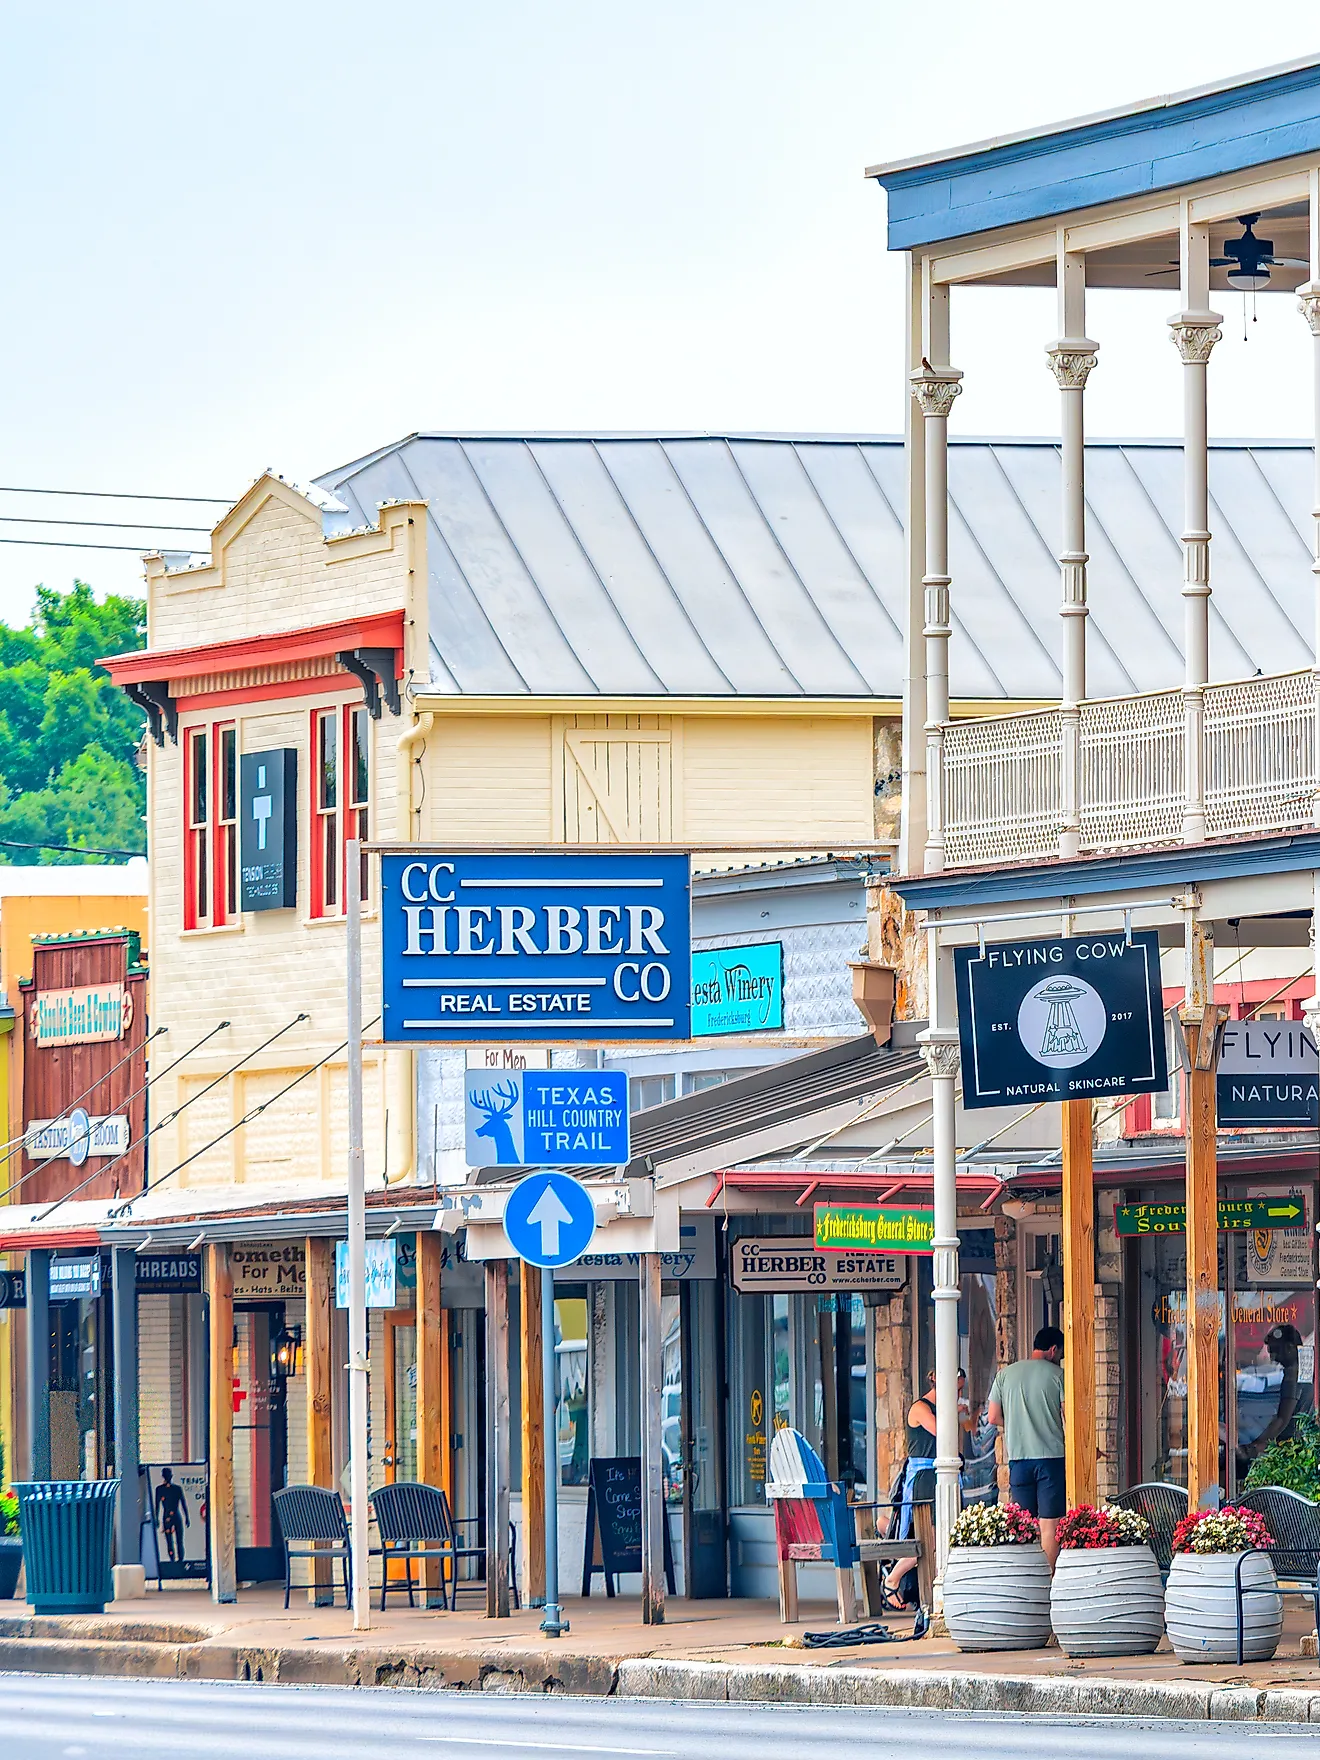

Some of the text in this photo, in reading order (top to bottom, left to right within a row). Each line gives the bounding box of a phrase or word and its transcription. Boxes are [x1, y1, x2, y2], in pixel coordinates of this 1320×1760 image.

[402, 862, 455, 903] CC
[401, 905, 671, 956] HERBER
[988, 941, 1126, 968] FLYING COW
[612, 962, 672, 1002] CO
[693, 964, 722, 1006] esta
[440, 993, 592, 1013] REAL ESTATE
[707, 1009, 752, 1028] Fredericksburg
[1111, 1011, 1133, 1021] 2017
[991, 1022, 1012, 1032] EST.
[537, 1087, 613, 1105] TEXAS
[1006, 1076, 1126, 1097] NATURAL SKINCARE
[1232, 1084, 1318, 1102] NATURA
[528, 1109, 623, 1128] HILL COUNTRY
[94, 1124, 119, 1146] ROOM
[541, 1132, 611, 1150] TRAIL
[1133, 1201, 1254, 1219] Frederburg
[822, 1212, 928, 1244] Fredericksburg General Store
[232, 1245, 307, 1264] ometh
[741, 1244, 760, 1256] CC
[741, 1256, 827, 1273] HERBER
[836, 1259, 896, 1273] ESTATE
[242, 1264, 307, 1285] For Me
[807, 1272, 828, 1285] CO
[831, 1275, 901, 1285] www.ccherber.com
[251, 1284, 273, 1294] Hats
[280, 1284, 303, 1294] Belts
[1230, 1290, 1264, 1324] General
[1266, 1295, 1290, 1324] Store
